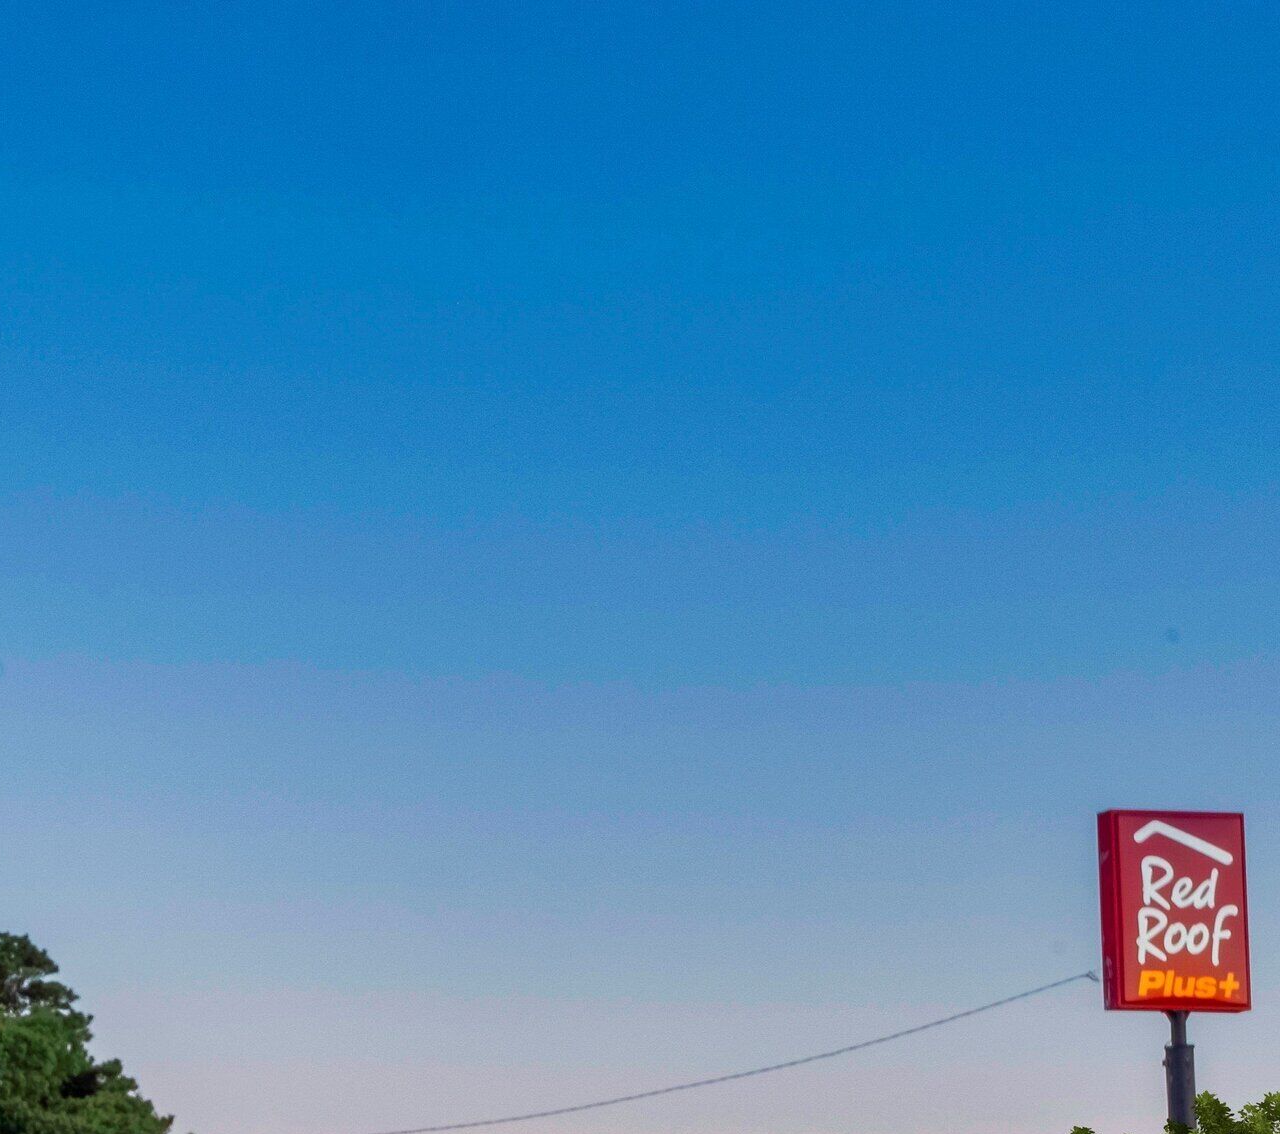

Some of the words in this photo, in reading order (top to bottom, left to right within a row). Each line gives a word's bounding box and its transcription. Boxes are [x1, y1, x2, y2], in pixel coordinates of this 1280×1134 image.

[1141, 855, 1219, 911] Red
[1136, 904, 1239, 967] Roof
[1138, 969, 1240, 998] Plus+
